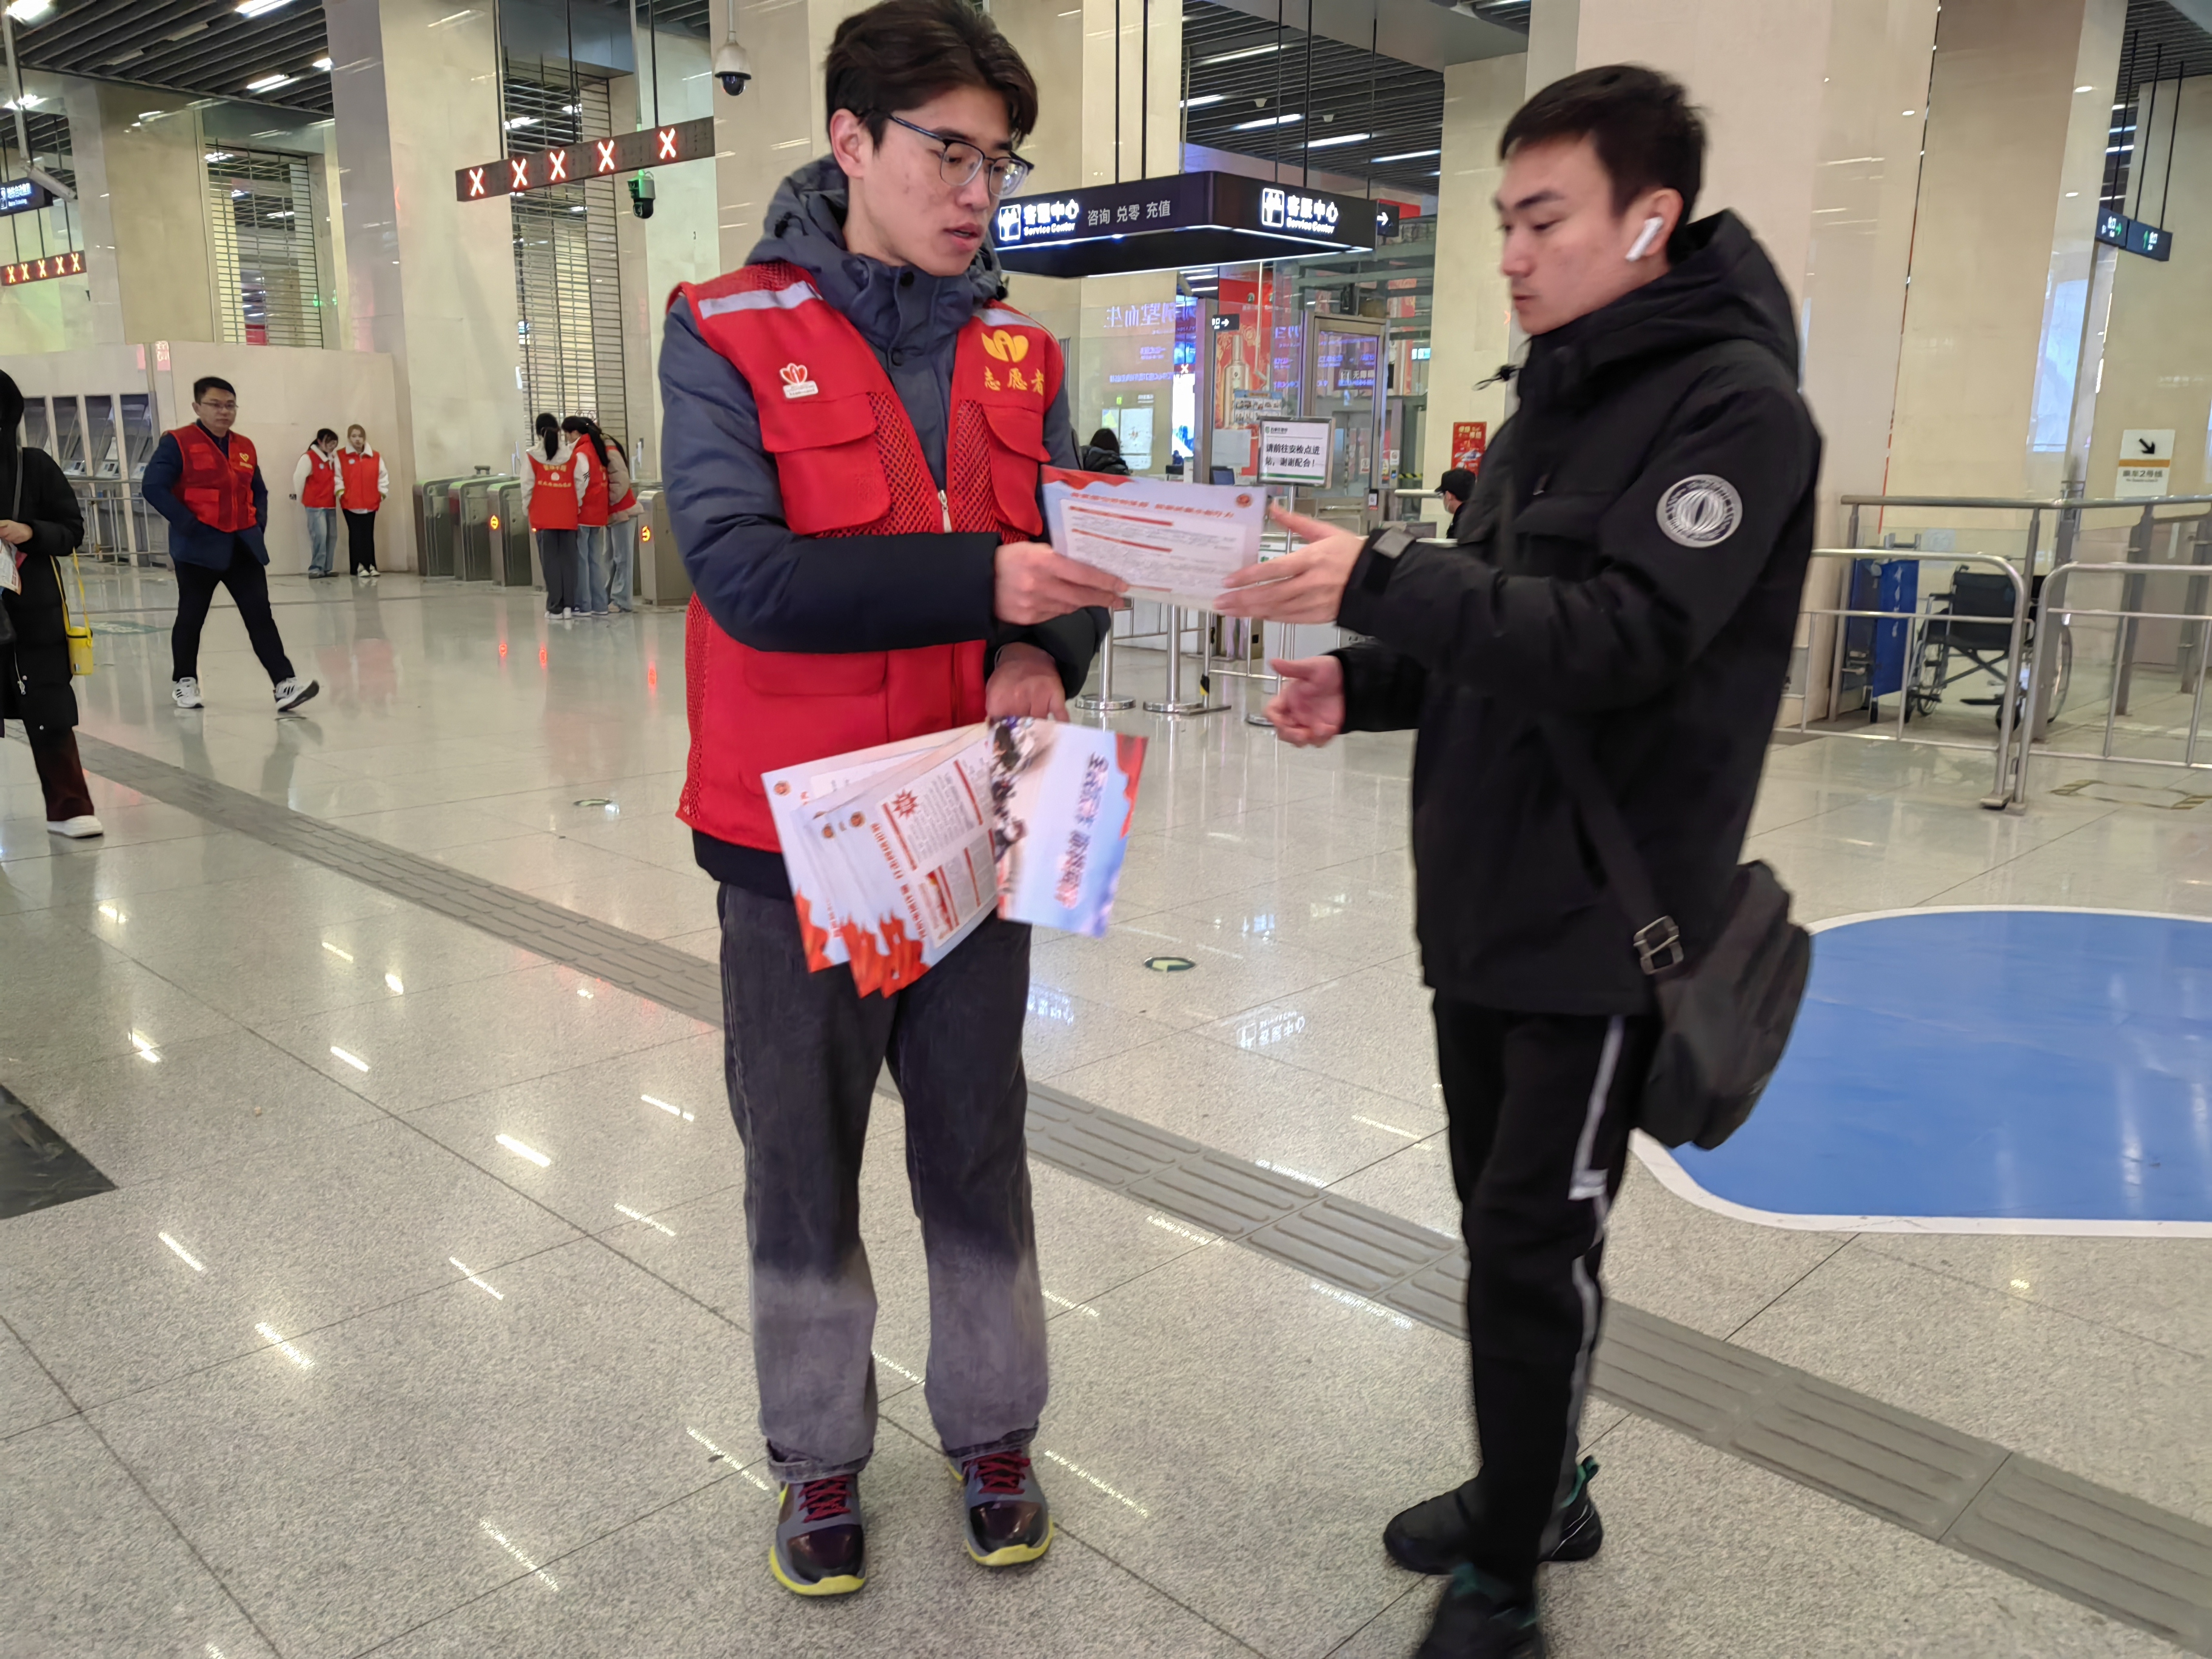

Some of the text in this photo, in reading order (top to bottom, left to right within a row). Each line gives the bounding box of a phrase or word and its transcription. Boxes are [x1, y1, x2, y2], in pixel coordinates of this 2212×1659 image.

[1088, 200, 1171, 226] 咨询 兑零 充值
[984, 366, 1044, 396] 志愿者
[1265, 443, 1320, 455] 请前往安检点进
